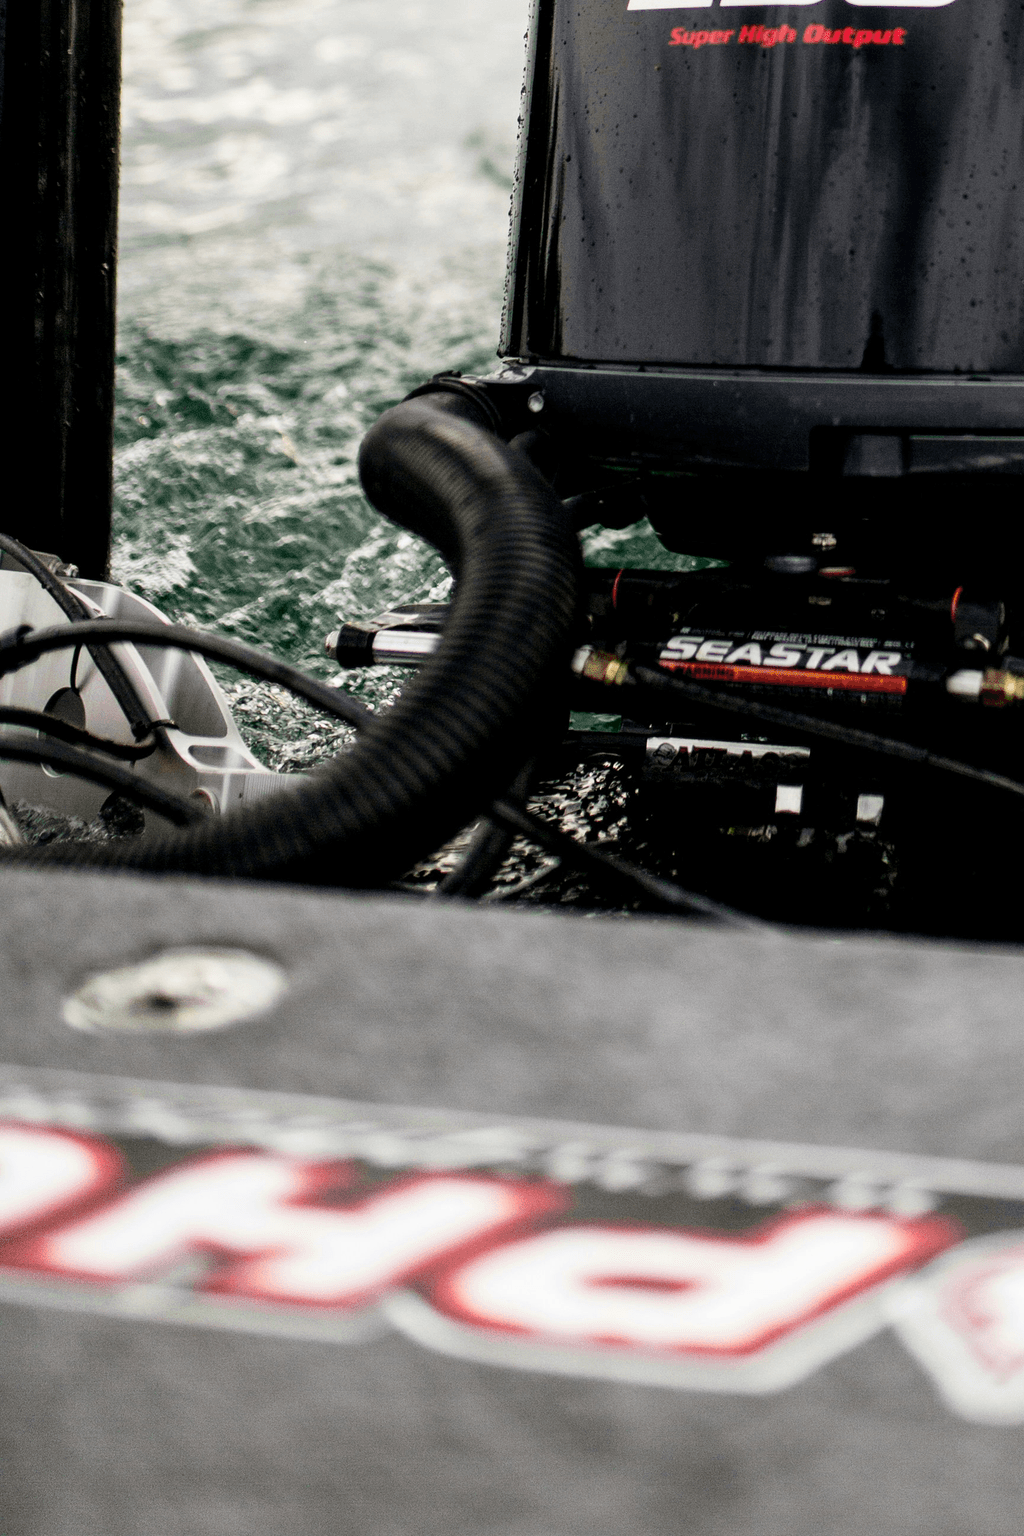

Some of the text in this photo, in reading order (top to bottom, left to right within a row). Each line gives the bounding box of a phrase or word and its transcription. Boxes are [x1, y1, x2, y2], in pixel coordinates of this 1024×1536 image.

[668, 23, 907, 49] Super High Output
[659, 635, 902, 676] SEASTAR
